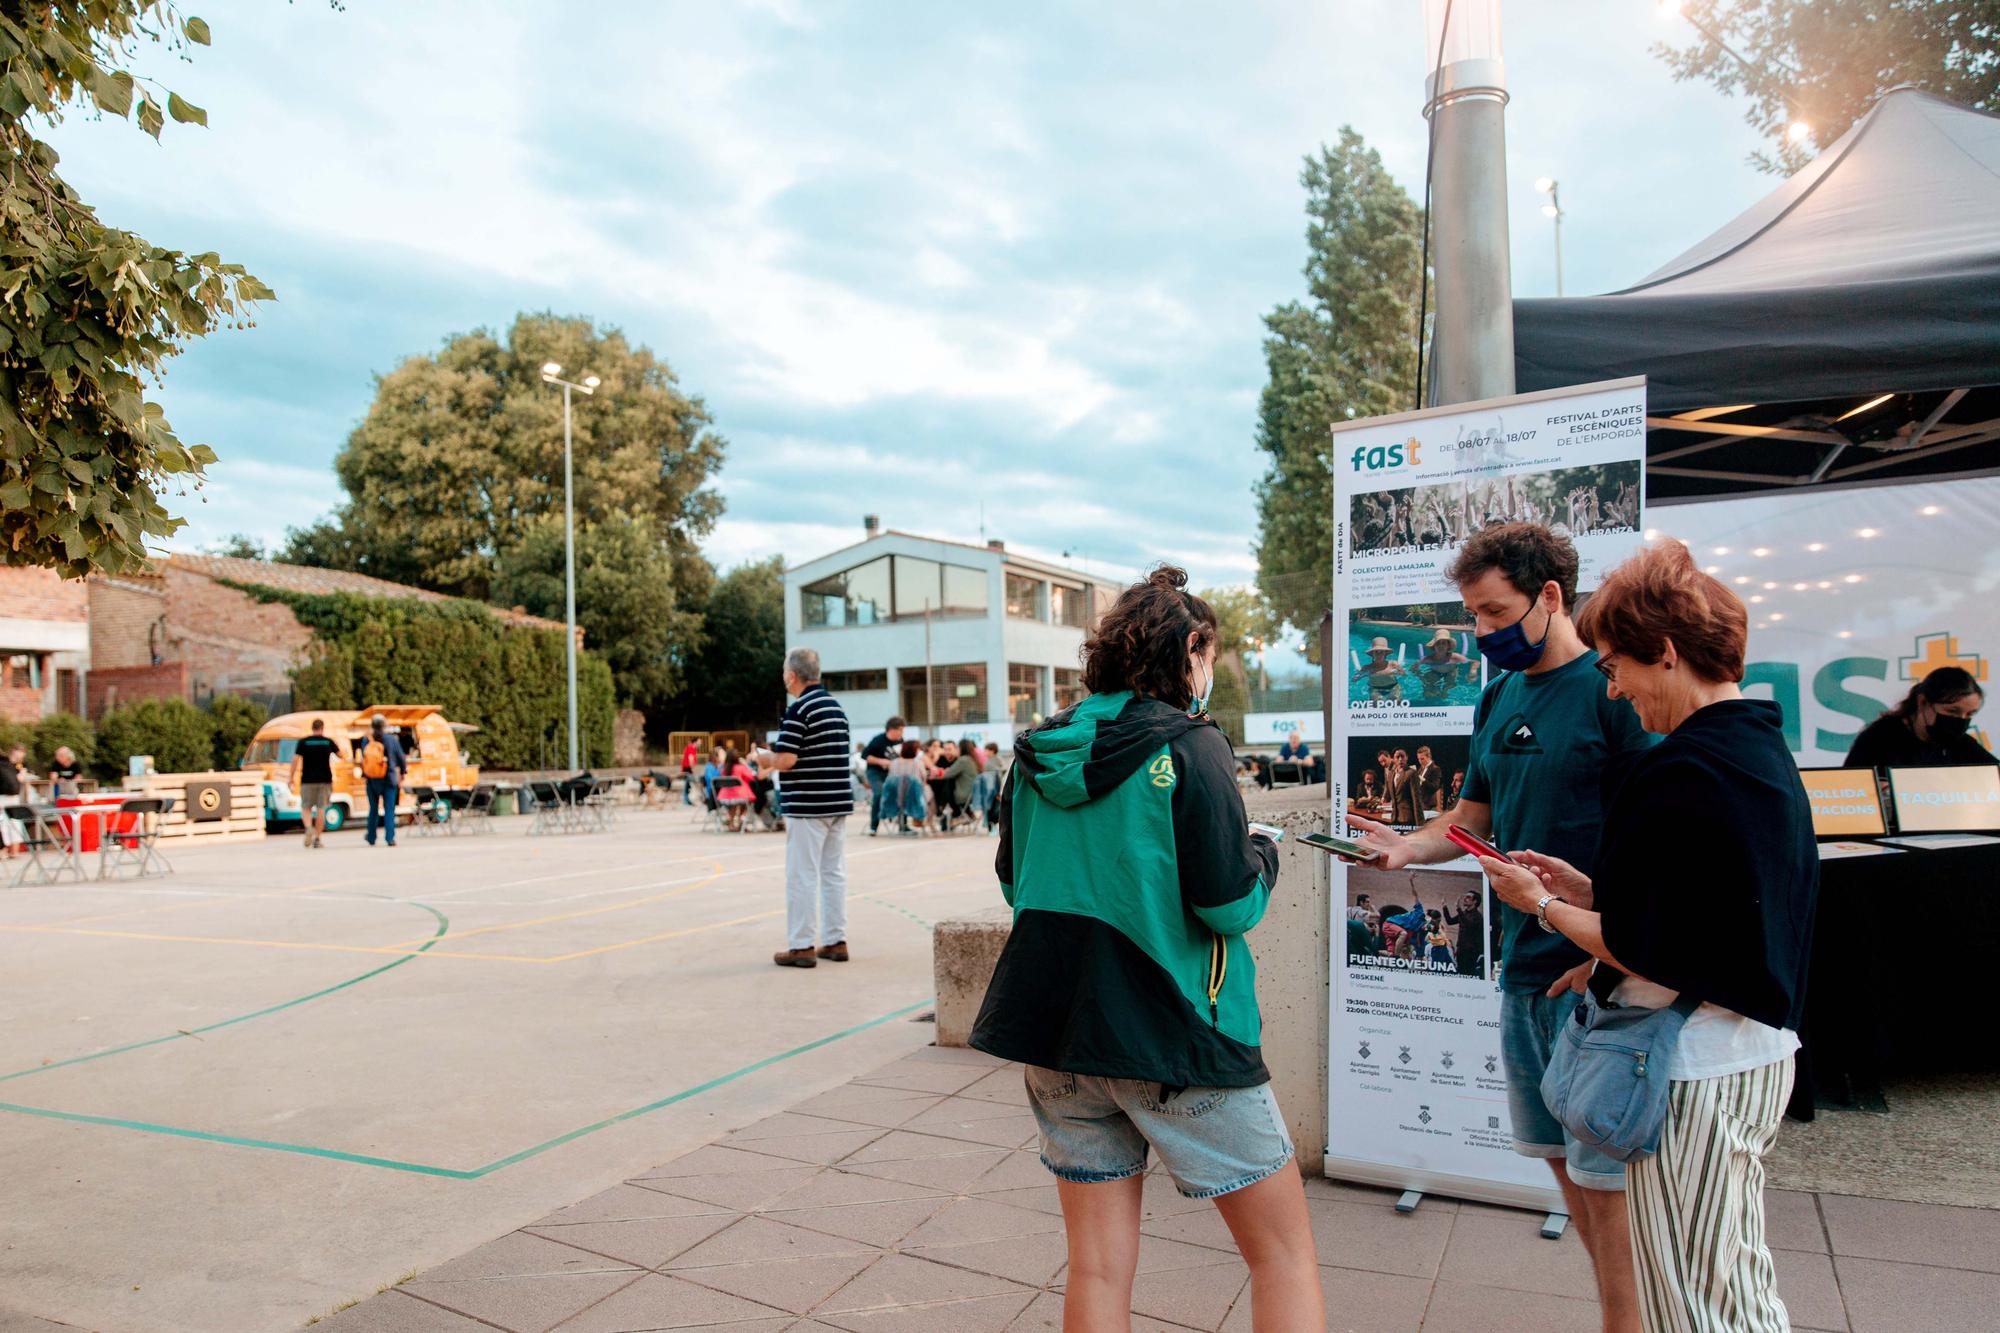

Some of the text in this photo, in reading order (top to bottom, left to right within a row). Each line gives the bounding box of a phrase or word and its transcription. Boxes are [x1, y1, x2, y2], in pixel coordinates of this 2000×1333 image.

[1546, 404, 1642, 426] FESTIVAL D'ARTS
[1440, 430, 1537, 453] DEL 08/07 AL 18/07
[1556, 436, 1572, 447] DE
[1352, 542, 1438, 560] MICROPOBLES
[1352, 562, 1435, 575] COLECTIVO LAMAJARA
[1350, 699, 1410, 709] OYE POLO
[1807, 788, 1866, 799] COLLIDA
[1900, 790, 2000, 806] TAQUILLA
[1335, 798, 1341, 808] de
[1812, 804, 1876, 816] TACIONS
[1350, 954, 1457, 973] FUENTEOVEJUNA
[1346, 998, 1442, 1014] 19:30h OBERTURA PORTES
[1346, 1006, 1464, 1025] 22:00h COMENÇA L'ESPECTACLE
[1476, 1020, 1500, 1028] GAUD
[1350, 1061, 1380, 1069] Ajuntament
[1390, 1066, 1421, 1075] Ajuntament
[1432, 1072, 1464, 1080] Ajuntament
[1475, 1076, 1507, 1084] Ajuntamen
